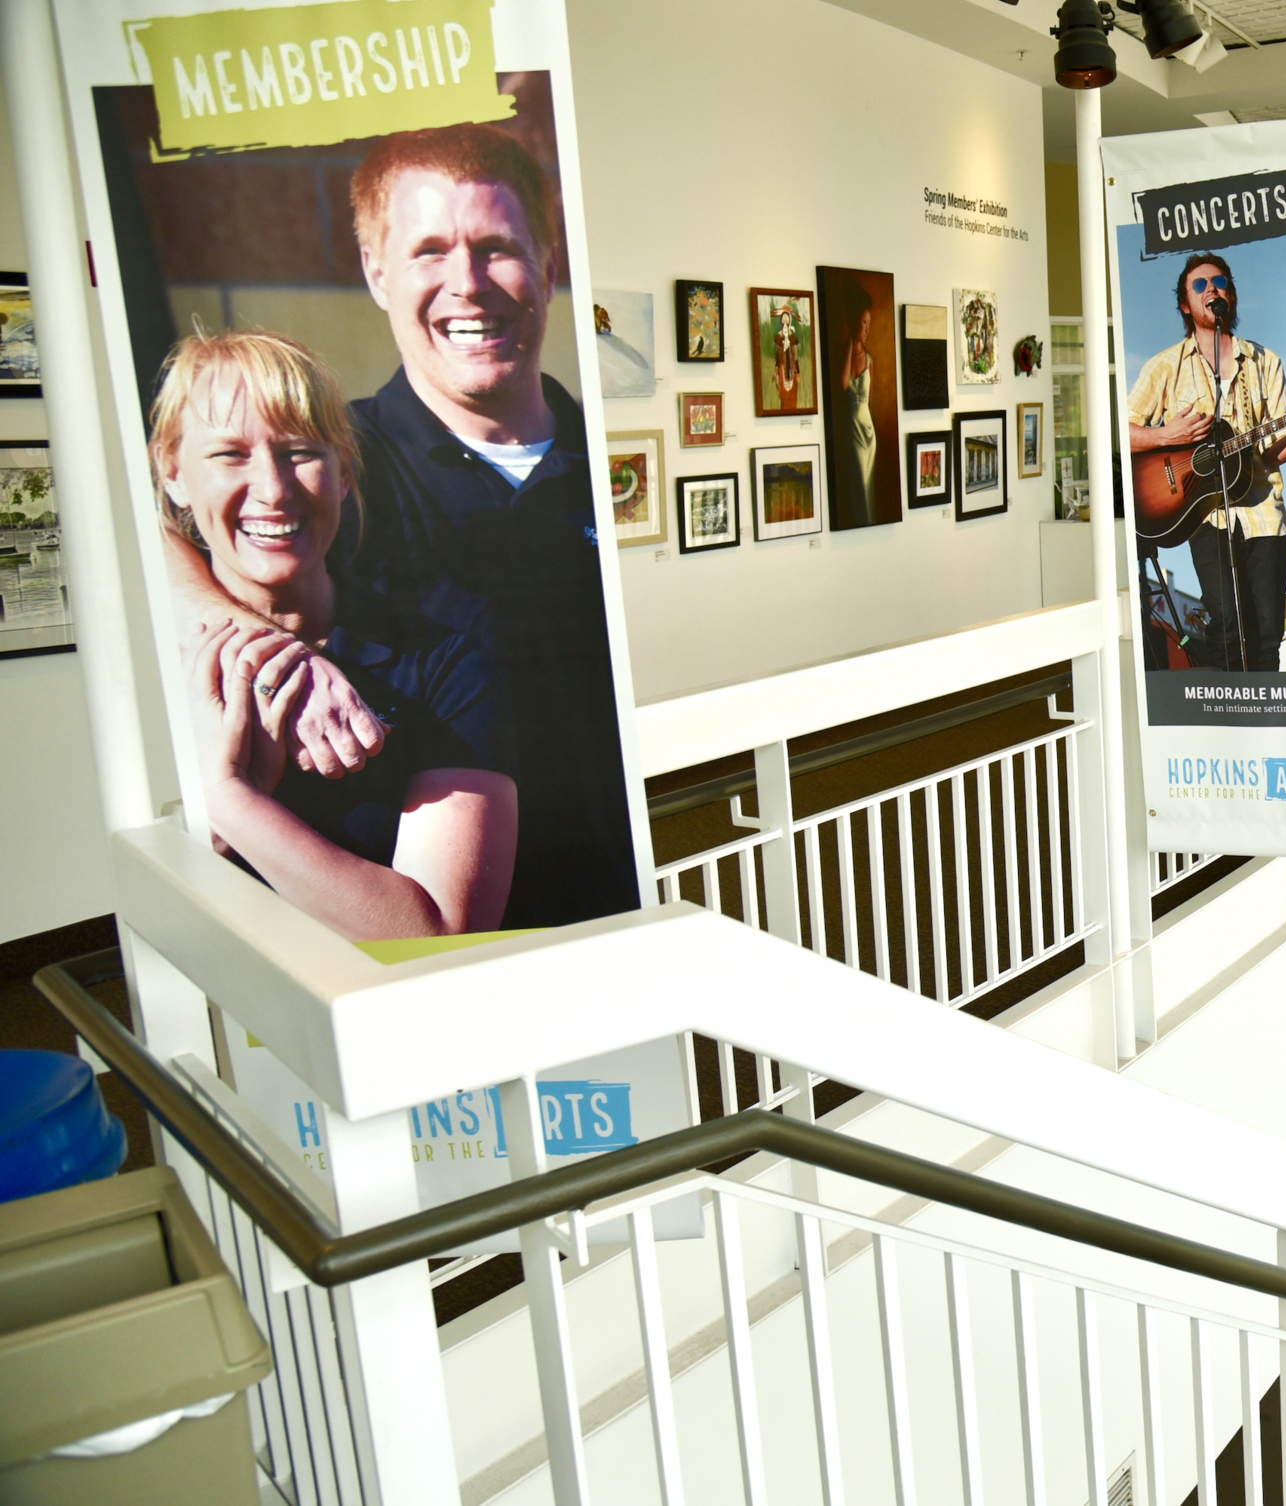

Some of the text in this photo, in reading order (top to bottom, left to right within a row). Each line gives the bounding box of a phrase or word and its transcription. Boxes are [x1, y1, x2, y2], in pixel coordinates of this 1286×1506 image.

[172, 21, 472, 120] MEMBERSHIP
[924, 186, 1008, 218] Spring Members' Exhibition
[925, 209, 1029, 242] Friends of the Hopkins Center for the Arts
[1184, 686, 1267, 700] MEMORABLE
[1203, 703, 1212, 712] In
[1226, 703, 1261, 713] intimate
[1167, 757, 1259, 787] HOPKINS
[1169, 787, 1260, 800] CENTER FOR THE
[294, 1091, 480, 1148] HINS
[541, 1091, 614, 1140] RTS
[447, 1140, 486, 1161] THE
